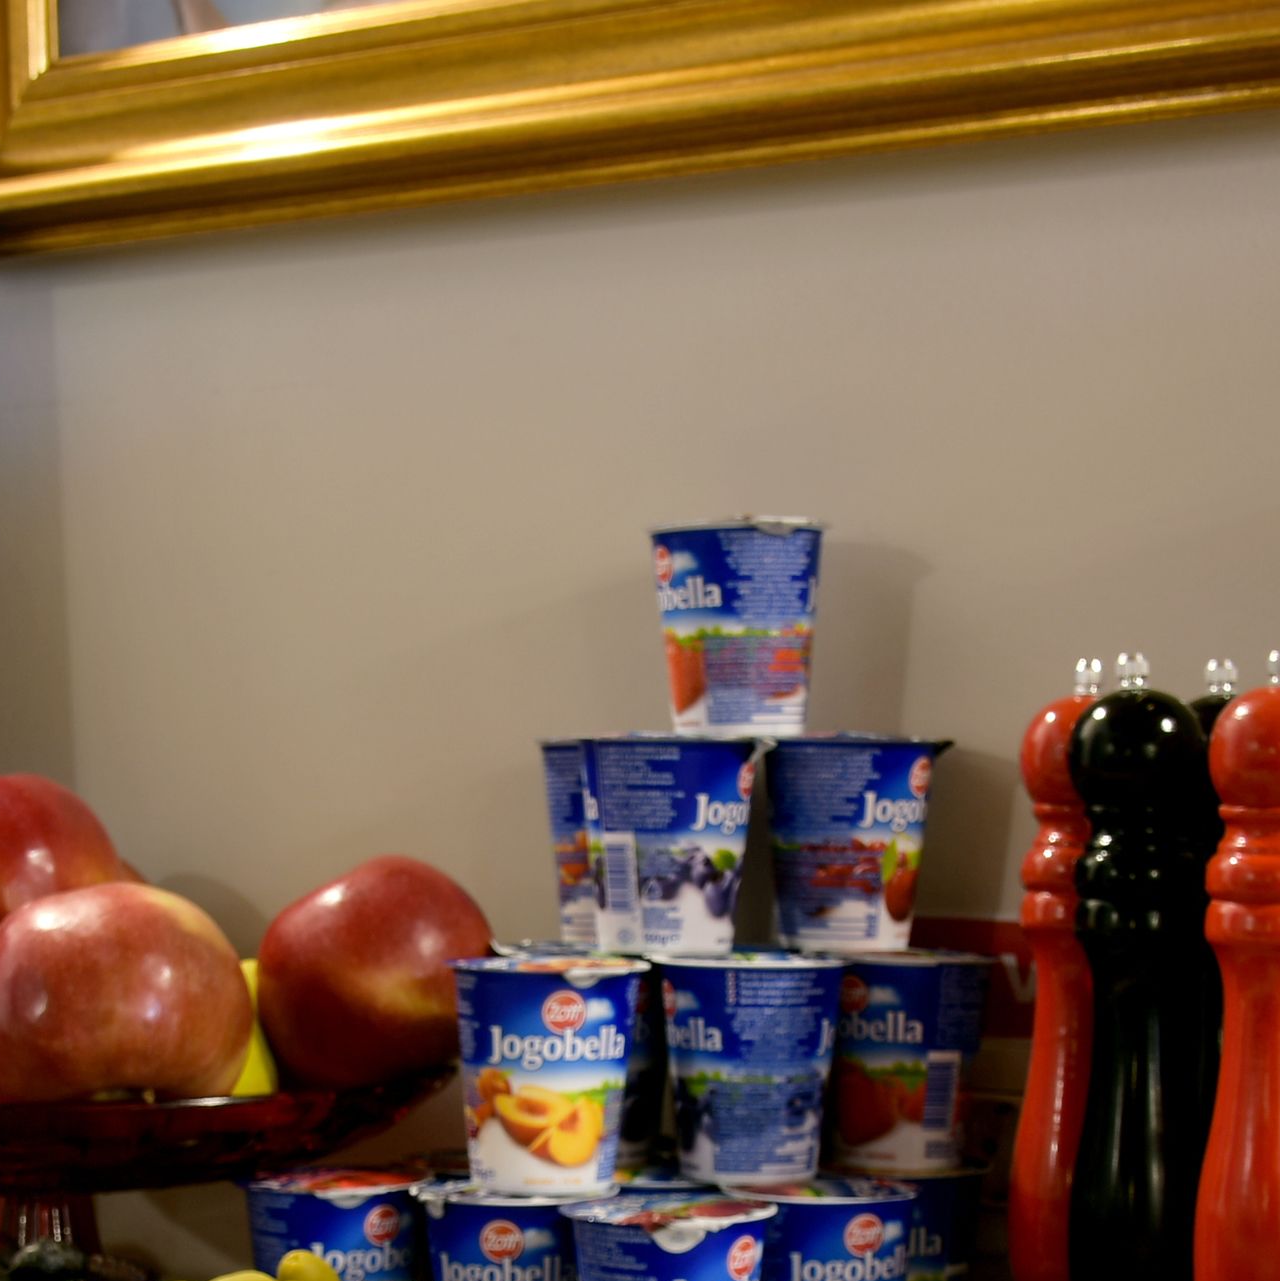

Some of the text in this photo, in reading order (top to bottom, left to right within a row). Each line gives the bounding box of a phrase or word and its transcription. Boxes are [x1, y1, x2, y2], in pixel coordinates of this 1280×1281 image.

[547, 1003, 583, 1021] Zott
[489, 1025, 626, 1070] Jogobella
[486, 1231, 519, 1251] Zott
[848, 1227, 881, 1245] Zott
